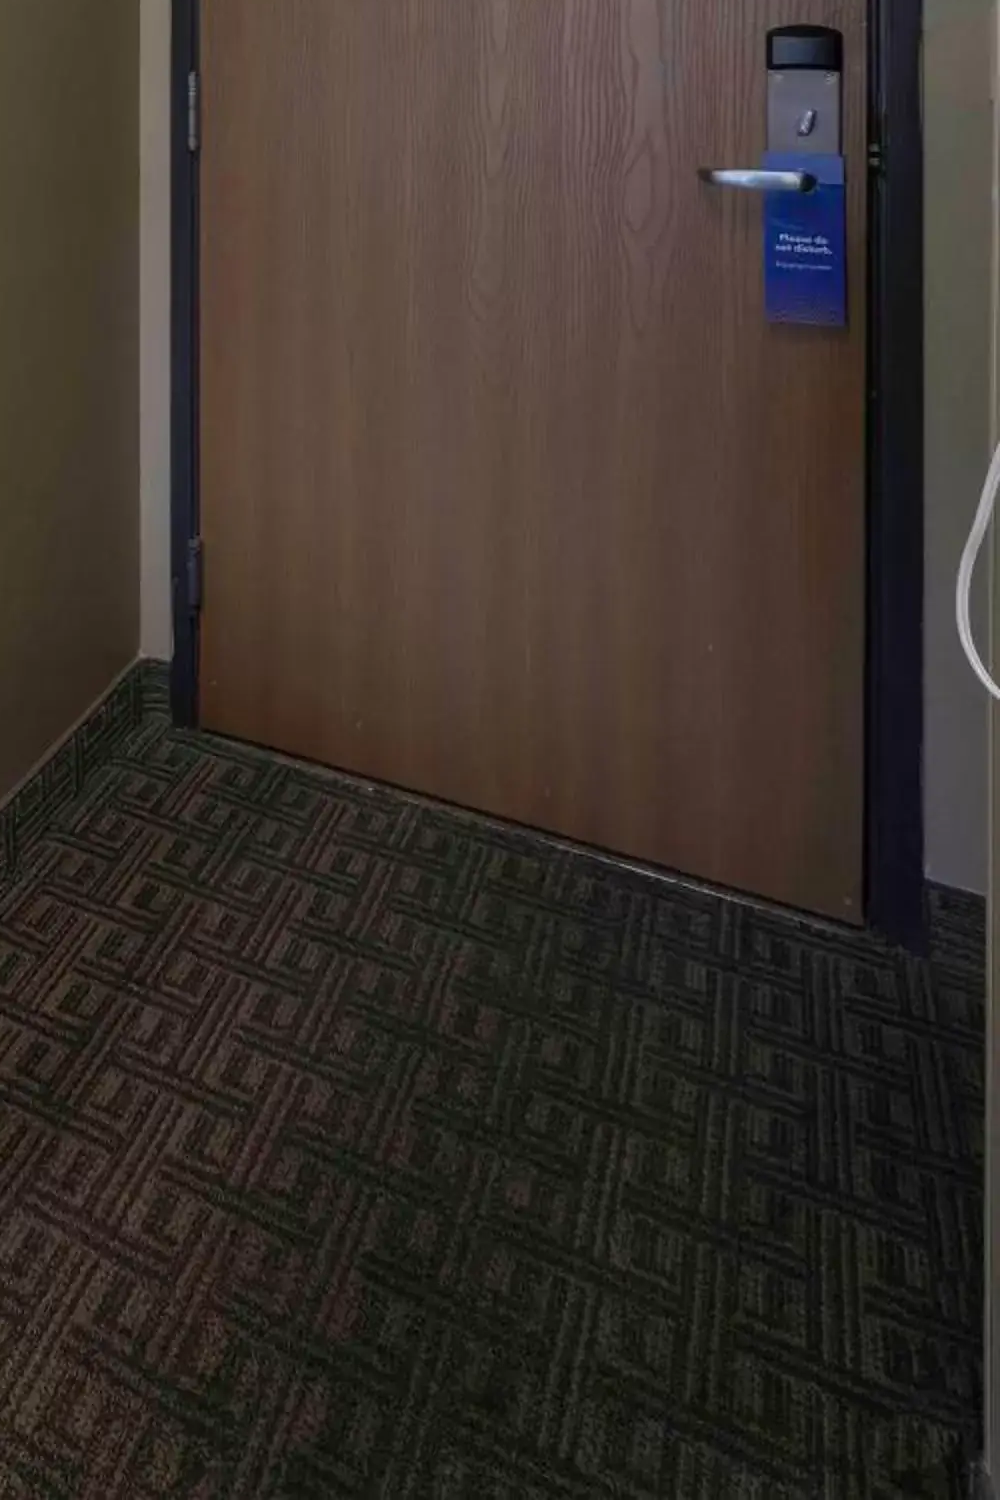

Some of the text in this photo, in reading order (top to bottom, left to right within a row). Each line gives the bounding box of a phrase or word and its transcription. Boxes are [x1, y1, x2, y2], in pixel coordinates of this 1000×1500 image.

[779, 233, 828, 245] Please do
[775, 244, 792, 252] not
